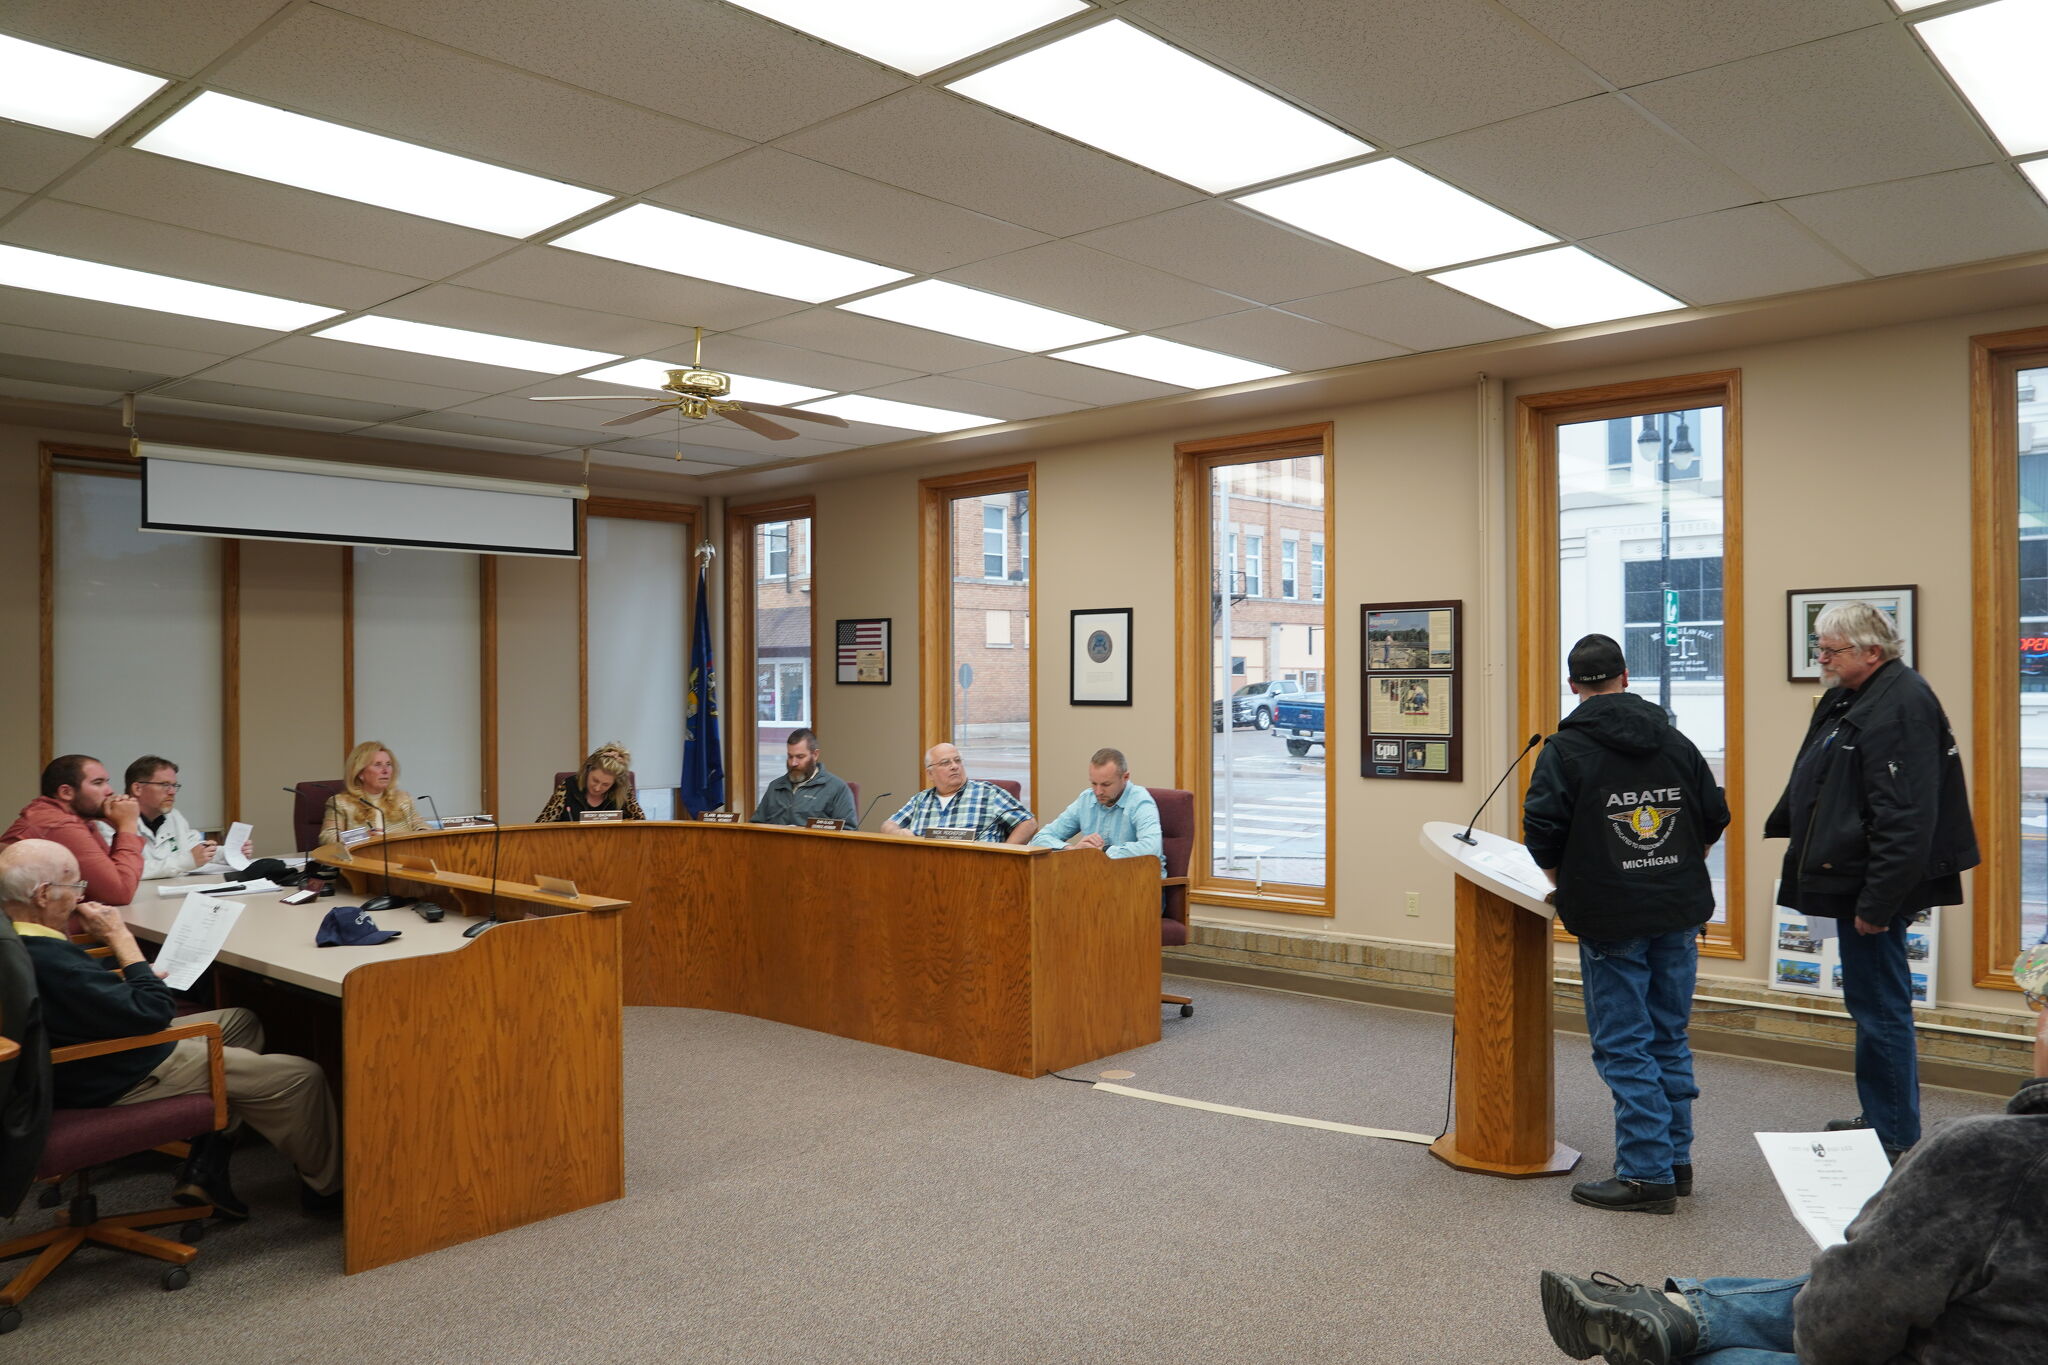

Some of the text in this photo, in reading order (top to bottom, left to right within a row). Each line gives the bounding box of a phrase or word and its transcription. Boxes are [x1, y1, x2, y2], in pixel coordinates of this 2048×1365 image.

[1376, 743, 1398, 760] tpo
[1606, 787, 1681, 807] ABATE
[1647, 849, 1655, 858] of
[1622, 855, 1678, 869] MICHIGAN
